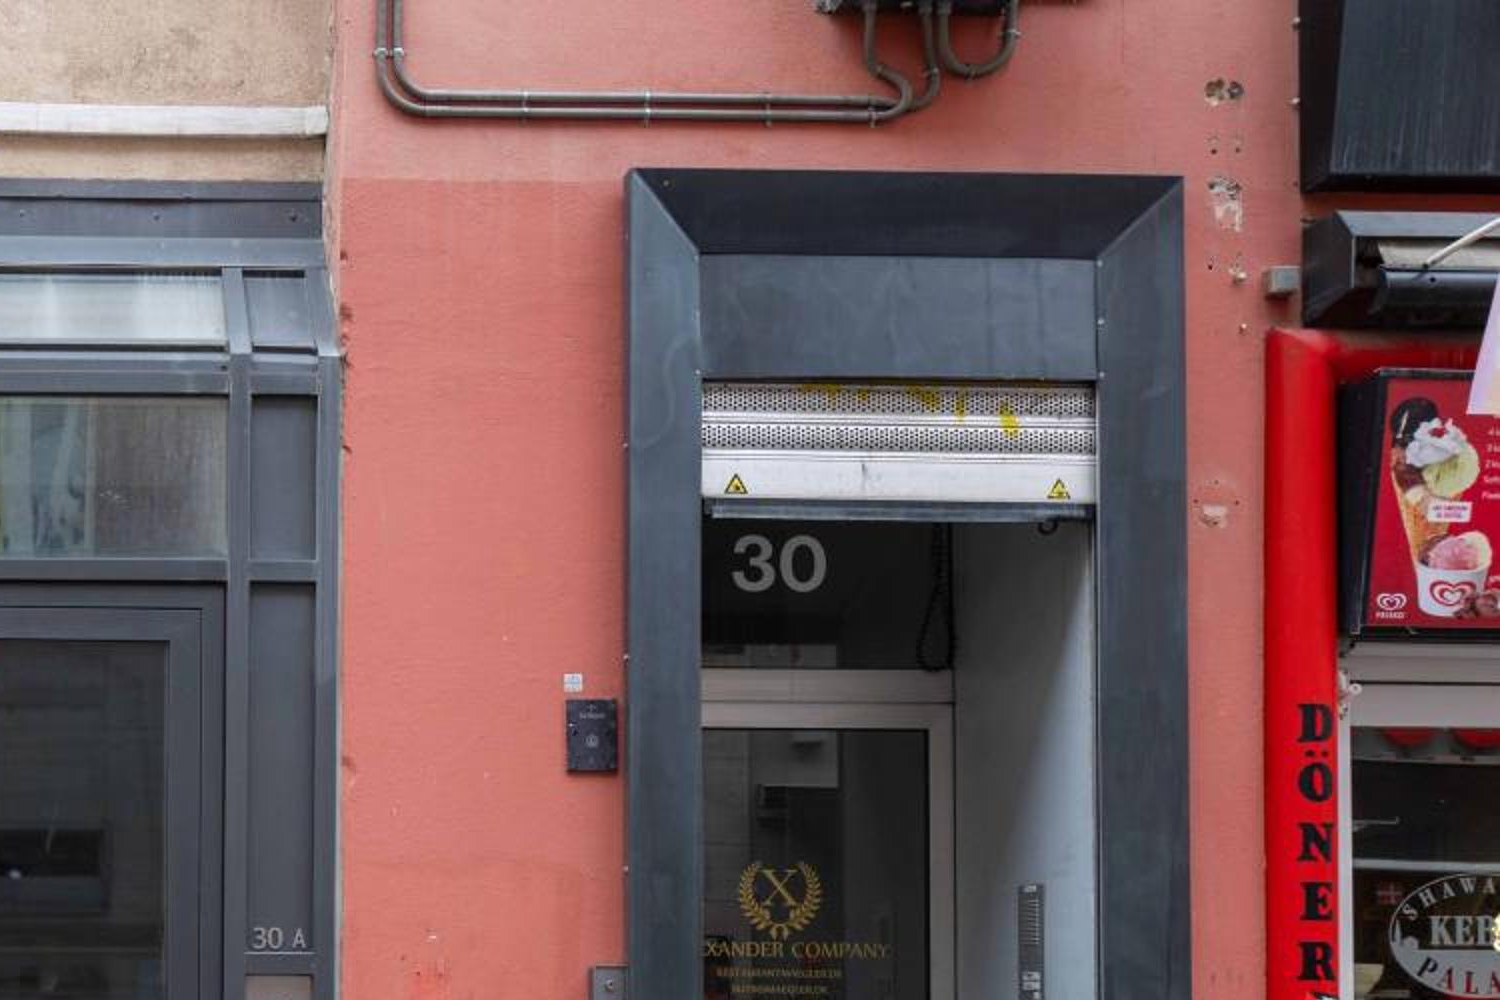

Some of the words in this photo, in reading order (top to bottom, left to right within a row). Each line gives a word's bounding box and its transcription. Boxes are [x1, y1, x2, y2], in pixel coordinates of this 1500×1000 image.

[731, 534, 827, 592] 30
[1297, 703, 1336, 982] DÖNER
[252, 927, 283, 949] 30
[292, 928, 307, 948] A
[791, 941, 889, 959] COMPANY
